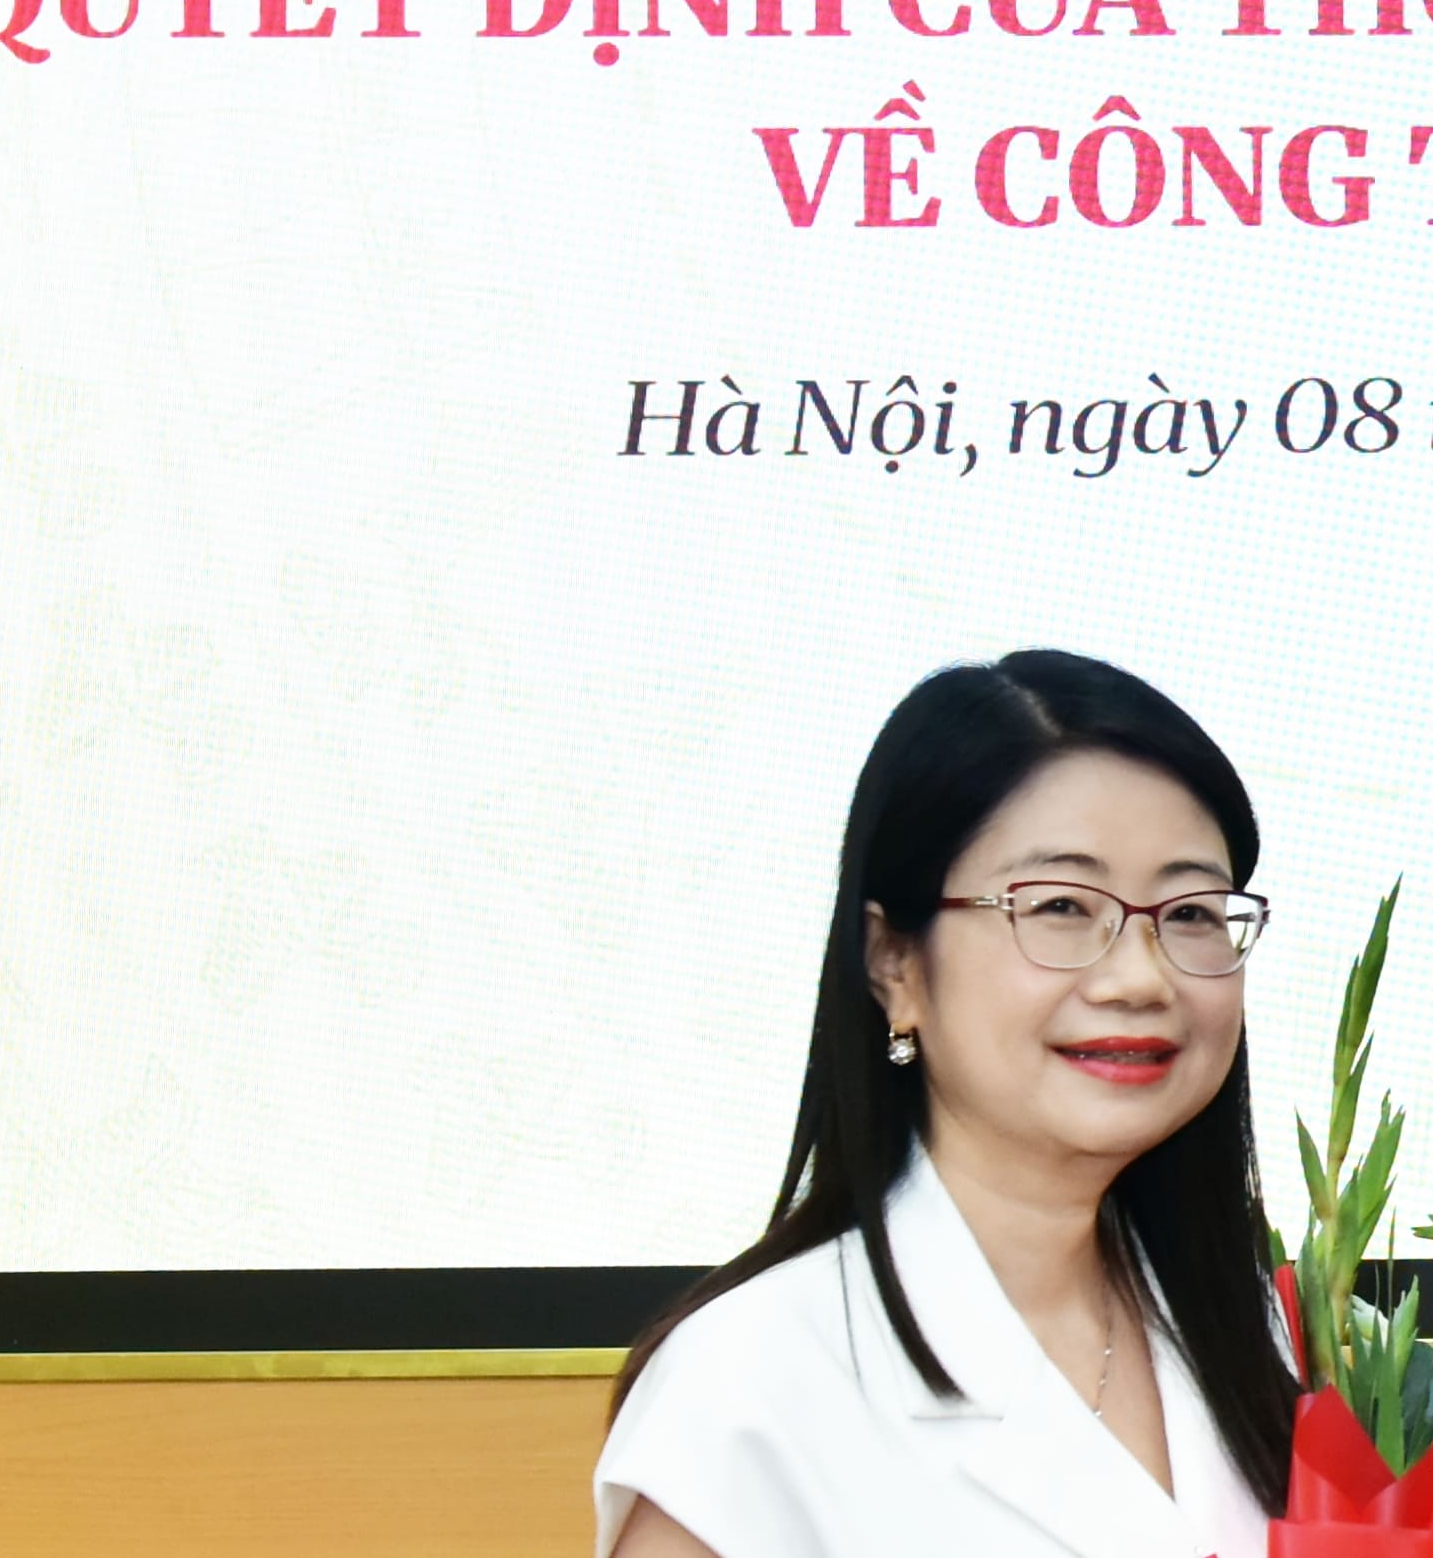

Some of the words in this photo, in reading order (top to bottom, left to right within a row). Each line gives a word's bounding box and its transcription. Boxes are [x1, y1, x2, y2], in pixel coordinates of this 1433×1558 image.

[753, 80, 941, 229] VỀ
[974, 96, 1375, 229] CÔNG
[618, 375, 760, 457] Hà
[785, 375, 982, 477] Nội,
[1008, 373, 1248, 480] ngày
[1275, 377, 1403, 455] 08
